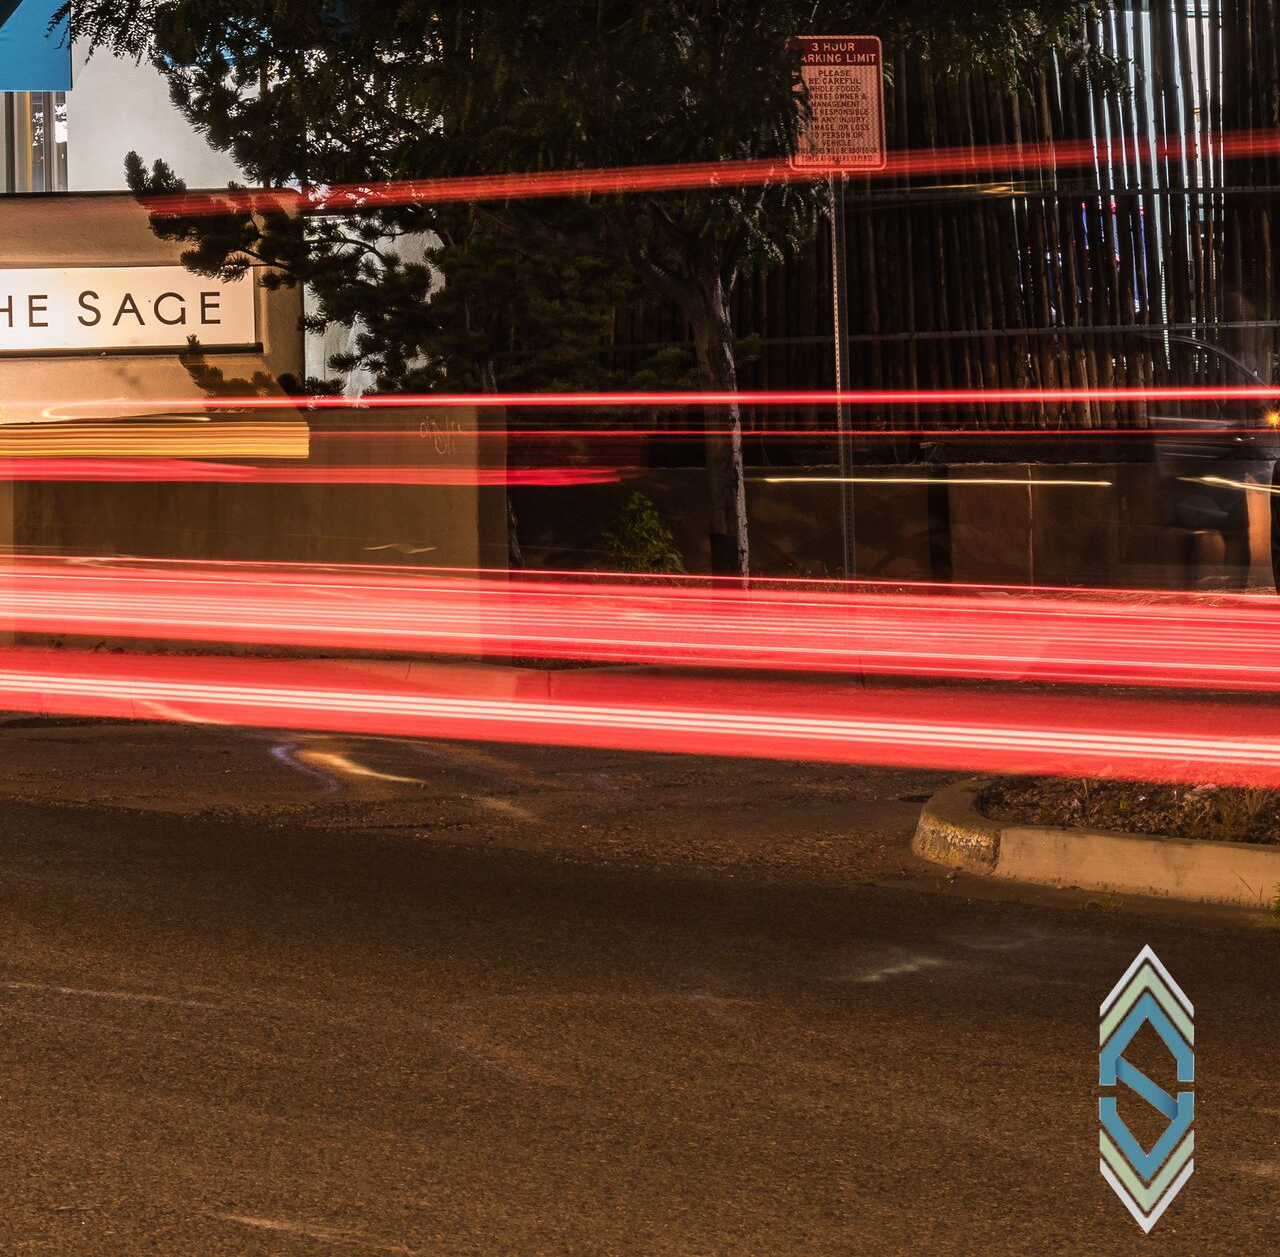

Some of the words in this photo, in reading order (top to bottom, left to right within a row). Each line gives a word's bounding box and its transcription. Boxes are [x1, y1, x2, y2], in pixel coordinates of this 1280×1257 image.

[811, 42, 819, 51] 3
[823, 42, 856, 51] HOUR
[801, 53, 842, 63] ARKING
[846, 53, 876, 63] LIMIT
[808, 77, 820, 85] BE
[822, 77, 862, 85] CAREFUL
[819, 108, 870, 116] RESPONSIBLE
[77, 290, 221, 327] SAGE
